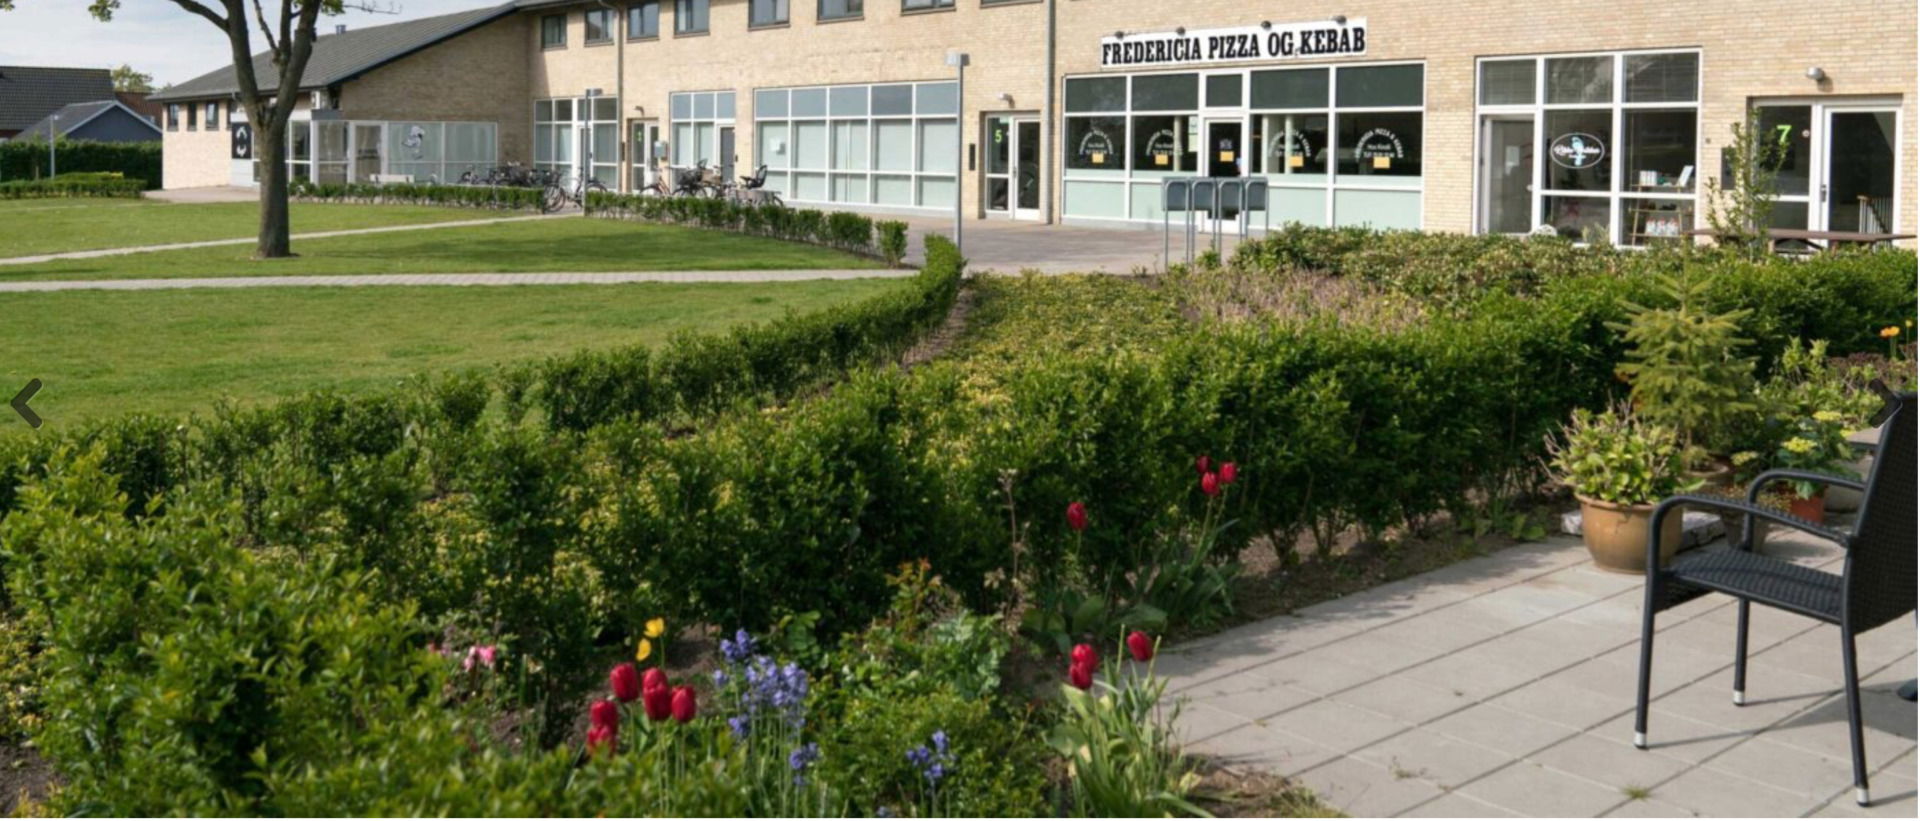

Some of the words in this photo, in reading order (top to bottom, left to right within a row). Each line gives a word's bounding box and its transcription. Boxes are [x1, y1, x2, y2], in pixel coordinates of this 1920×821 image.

[1102, 38, 1202, 65] FREDERICIA
[1208, 34, 1260, 59] PIZZA
[1267, 31, 1294, 56] OG
[1300, 27, 1366, 54] KEBAB
[995, 129, 1002, 143] 5
[1776, 124, 1792, 144] 7
